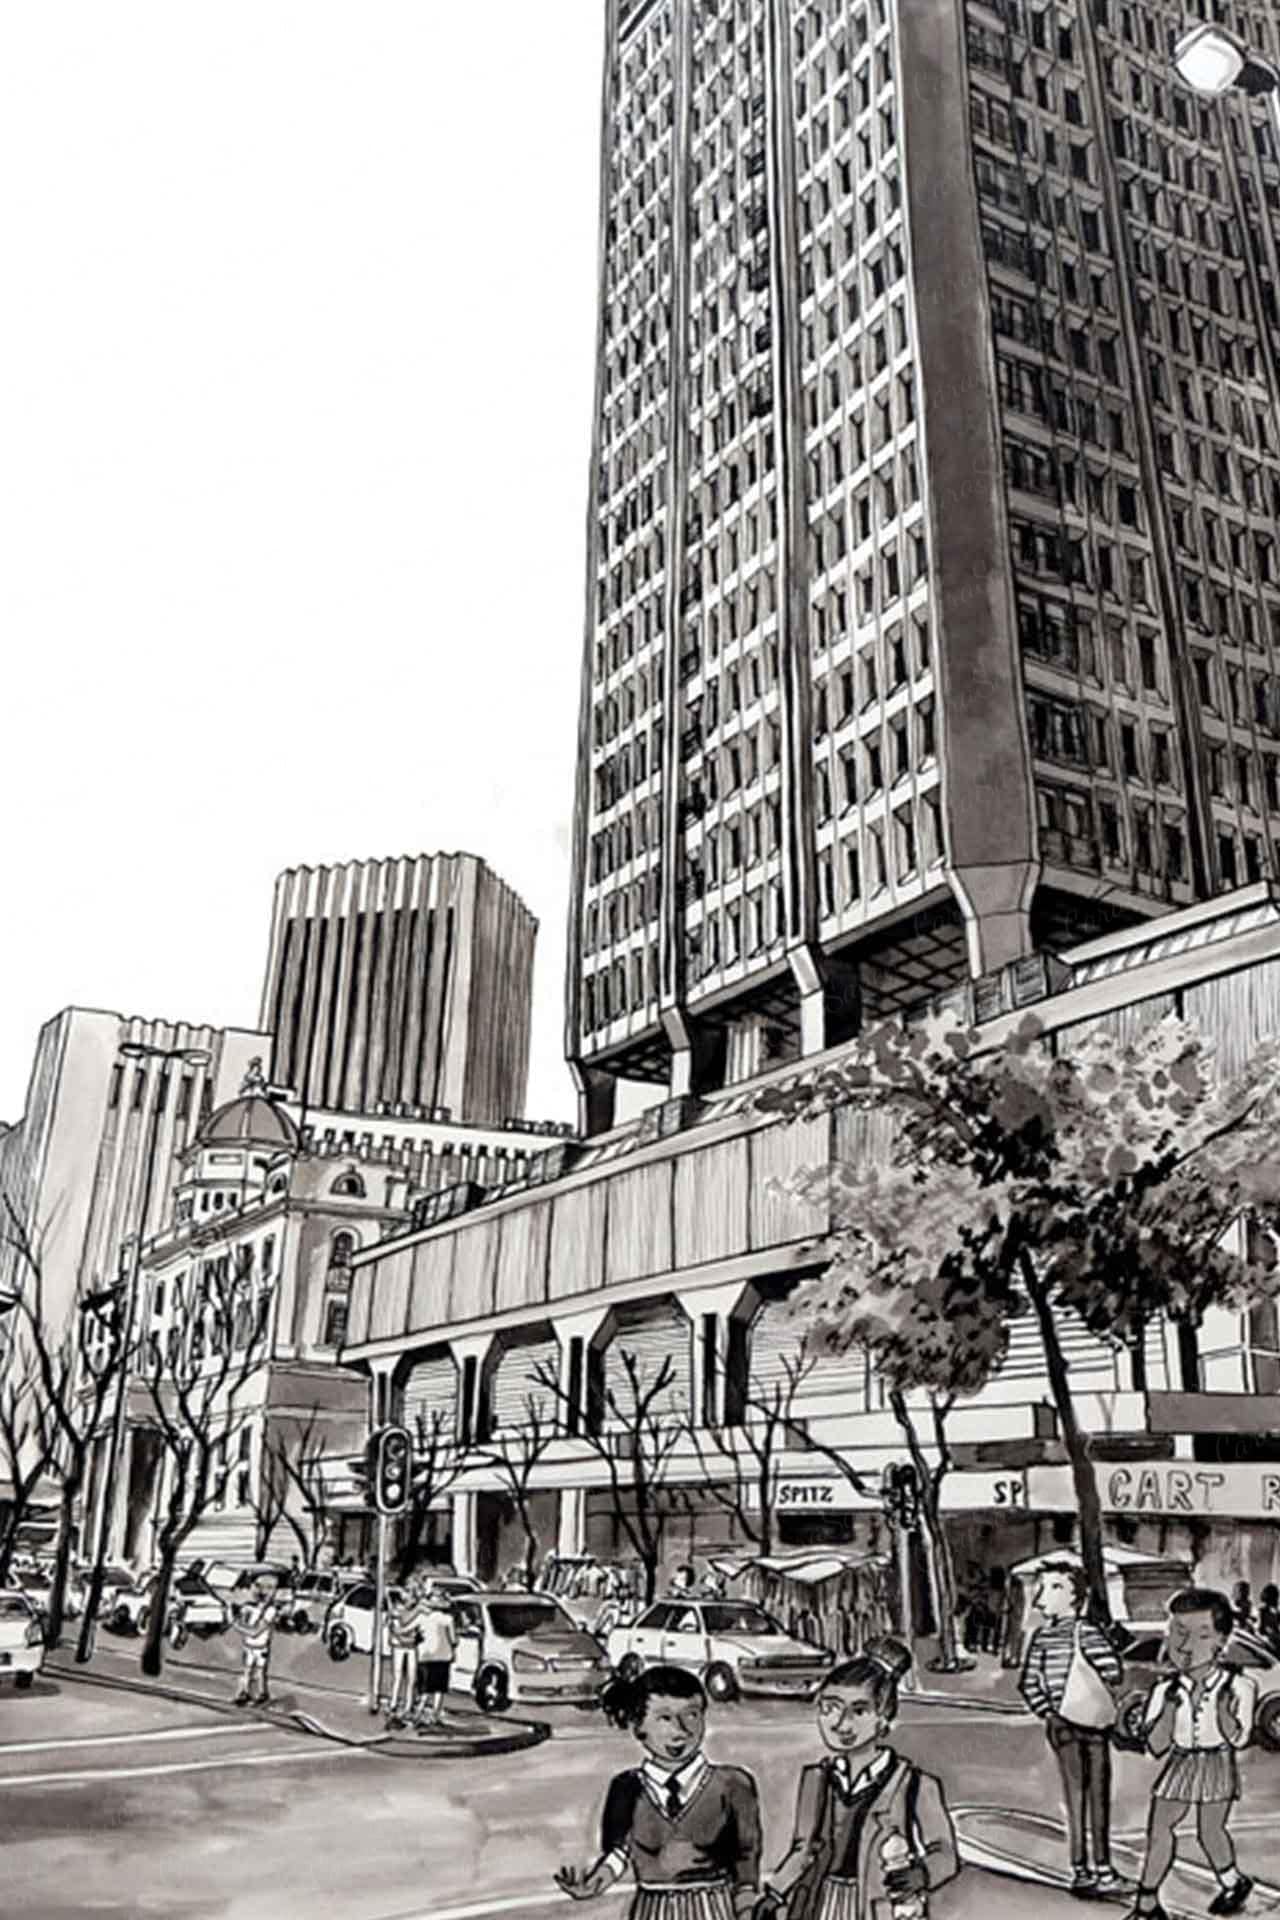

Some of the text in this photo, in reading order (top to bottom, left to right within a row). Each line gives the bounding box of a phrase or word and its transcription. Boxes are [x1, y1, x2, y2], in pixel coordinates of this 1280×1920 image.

[779, 1484, 833, 1504] SPITZ
[993, 1480, 1023, 1505] SP
[1108, 1469, 1225, 1511] CART
